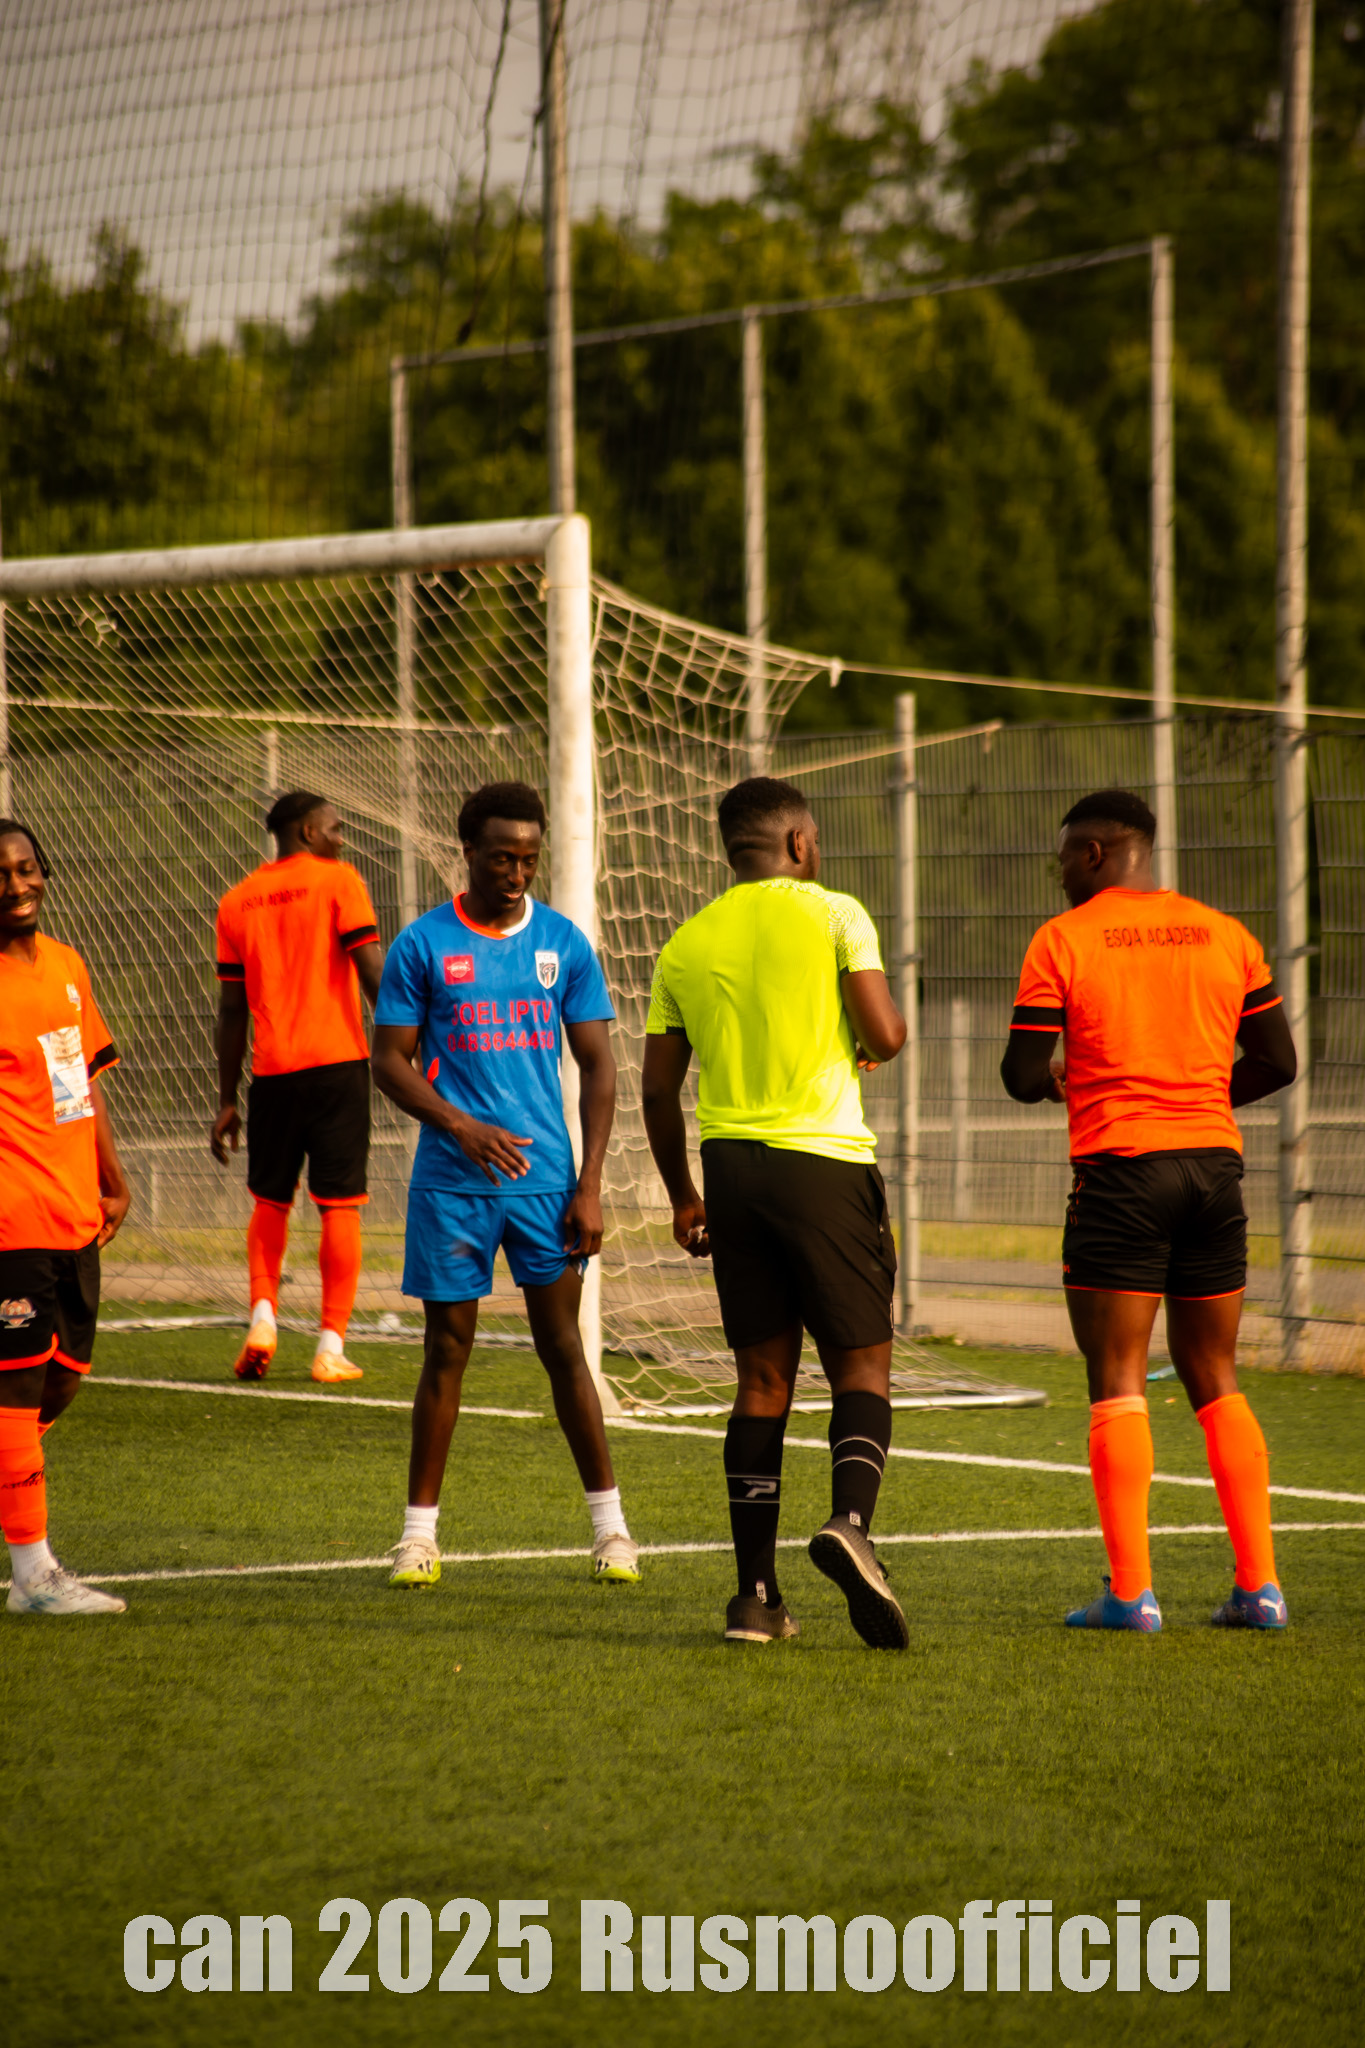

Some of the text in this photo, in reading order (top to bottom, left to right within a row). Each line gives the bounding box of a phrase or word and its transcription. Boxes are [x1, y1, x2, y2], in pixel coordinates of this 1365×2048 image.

[1103, 926, 1211, 948] ESOA ACADEMY
[451, 1000, 553, 1026] JOEL IPTV
[447, 1030, 554, 1052] 0483644450
